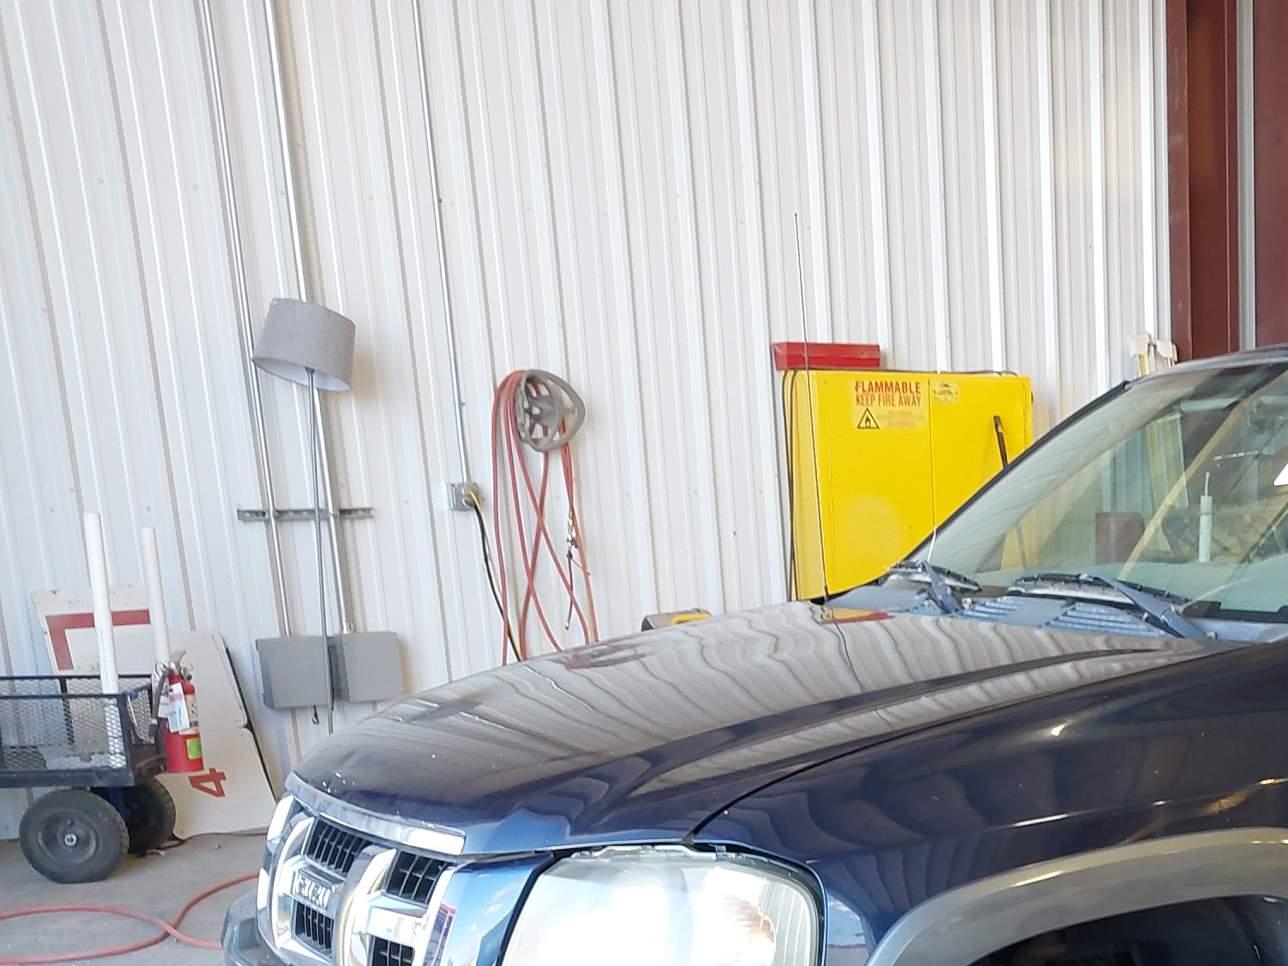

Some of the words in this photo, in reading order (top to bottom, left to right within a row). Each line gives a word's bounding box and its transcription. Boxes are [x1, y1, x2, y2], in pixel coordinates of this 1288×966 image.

[855, 380, 921, 394] FLAMMABLE
[855, 394, 876, 406] KEEP
[878, 394, 896, 407] FIRE
[898, 395, 921, 407] AWAY
